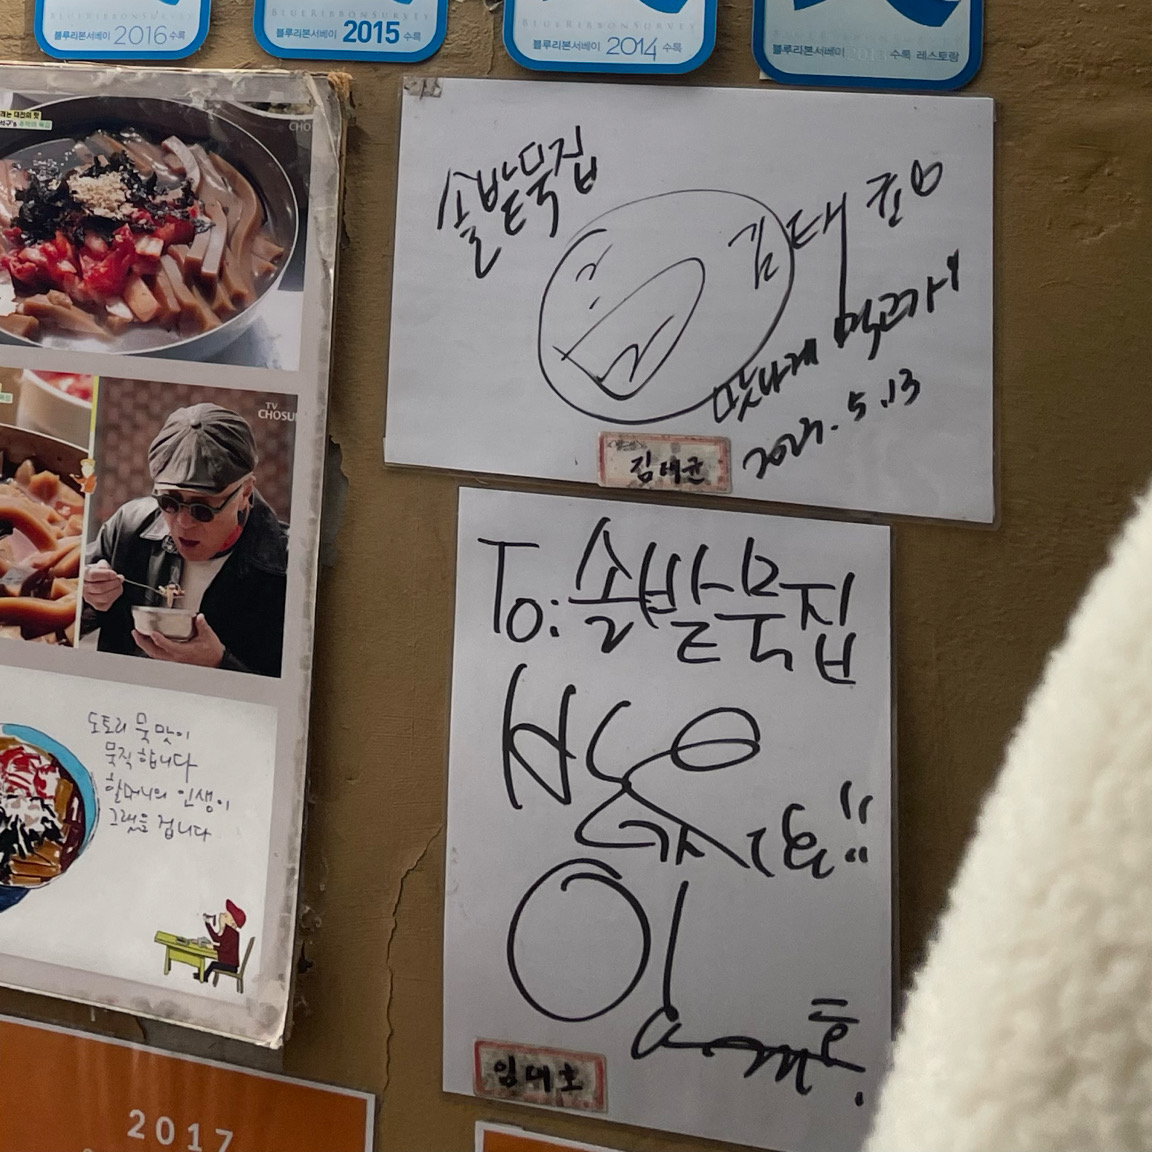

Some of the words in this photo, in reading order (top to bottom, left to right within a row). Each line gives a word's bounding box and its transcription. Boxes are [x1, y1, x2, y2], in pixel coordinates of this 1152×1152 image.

[54, 29, 111, 41] 블루리본서베이
[112, 25, 168, 46] 2016
[169, 30, 186, 41] 수록
[276, 27, 337, 40] 블루리본서베이
[342, 19, 400, 45] 2015
[403, 31, 422, 42] 수록
[532, 38, 601, 52] 블루리본서베이
[605, 36, 659, 62] 2014
[662, 42, 682, 53] 수록
[773, 43, 845, 57] 블루리본서베이
[890, 50, 911, 60] 수록
[916, 50, 960, 62] 레스토랑
[265, 402, 278, 410] TV
[178, 788, 230, 814] 인생이
[127, 1109, 234, 1152] 2017
